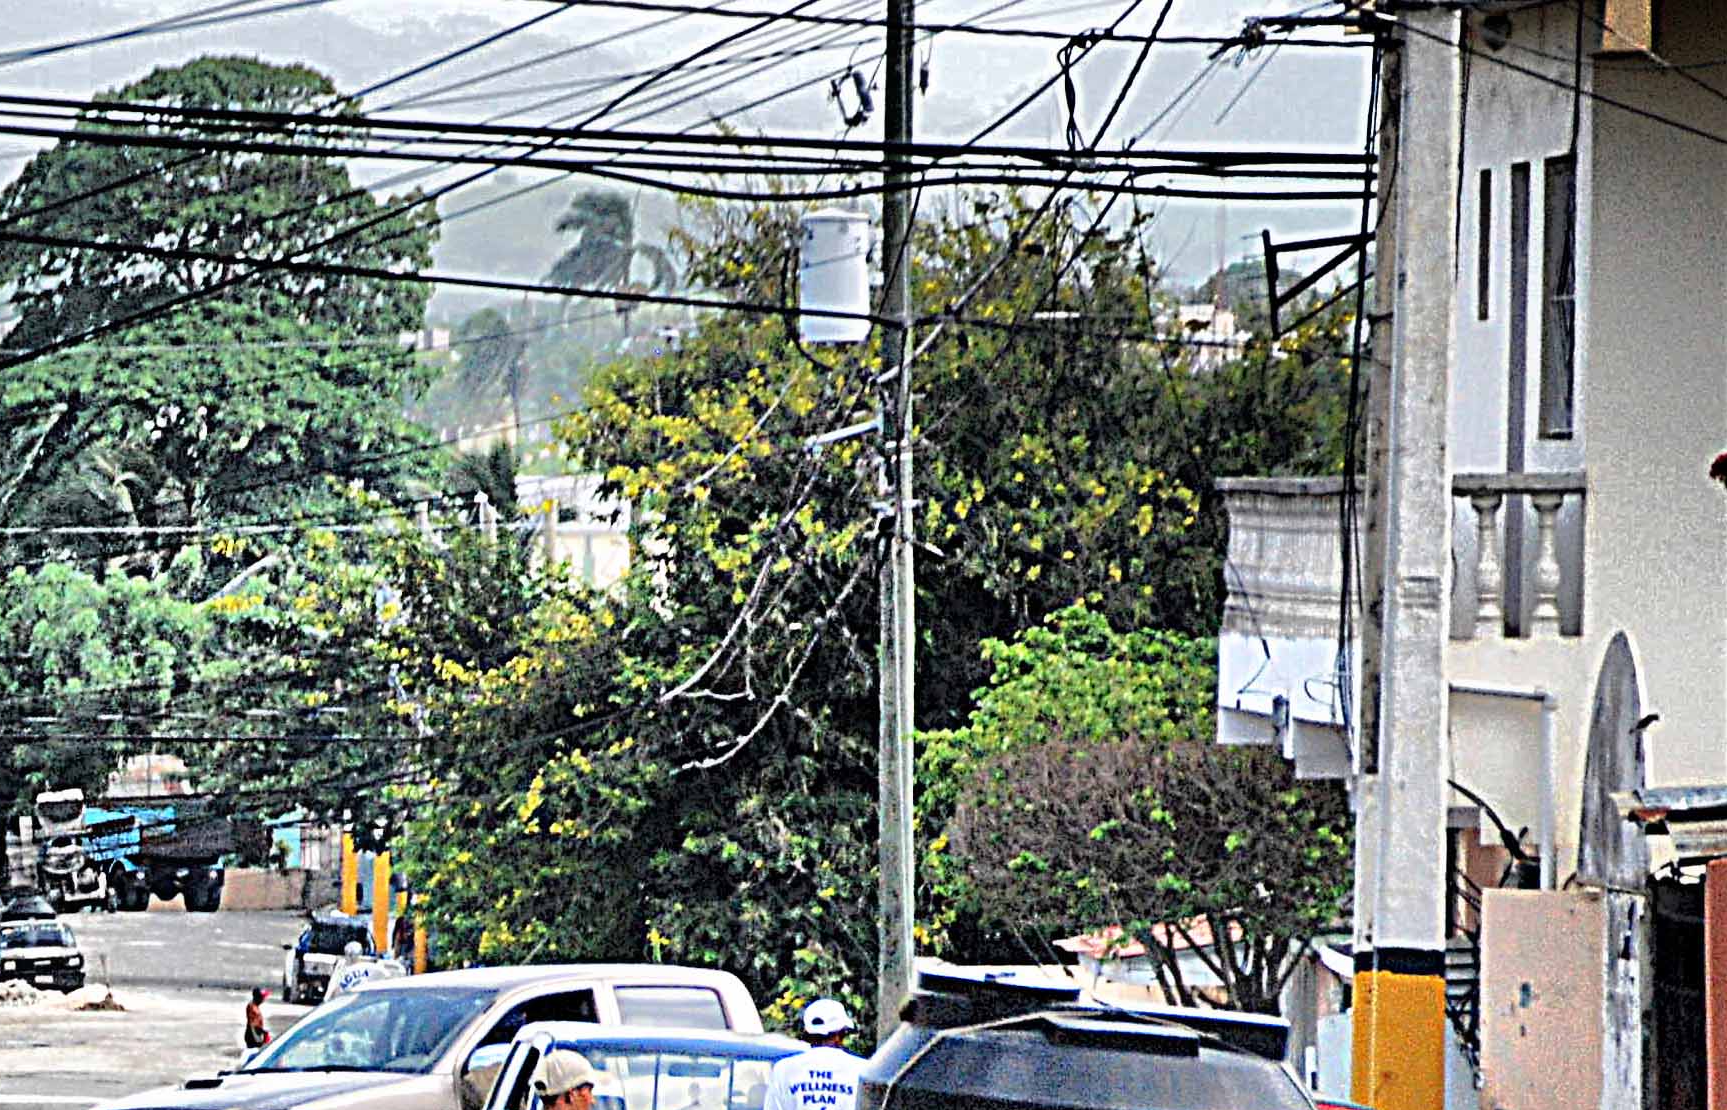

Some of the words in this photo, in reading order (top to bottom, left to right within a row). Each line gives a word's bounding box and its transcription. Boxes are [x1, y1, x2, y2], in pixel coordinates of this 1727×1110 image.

[809, 1070, 832, 1079] THE
[789, 1082, 853, 1095] WELLNESS
[803, 1094, 836, 1105] PLAN
